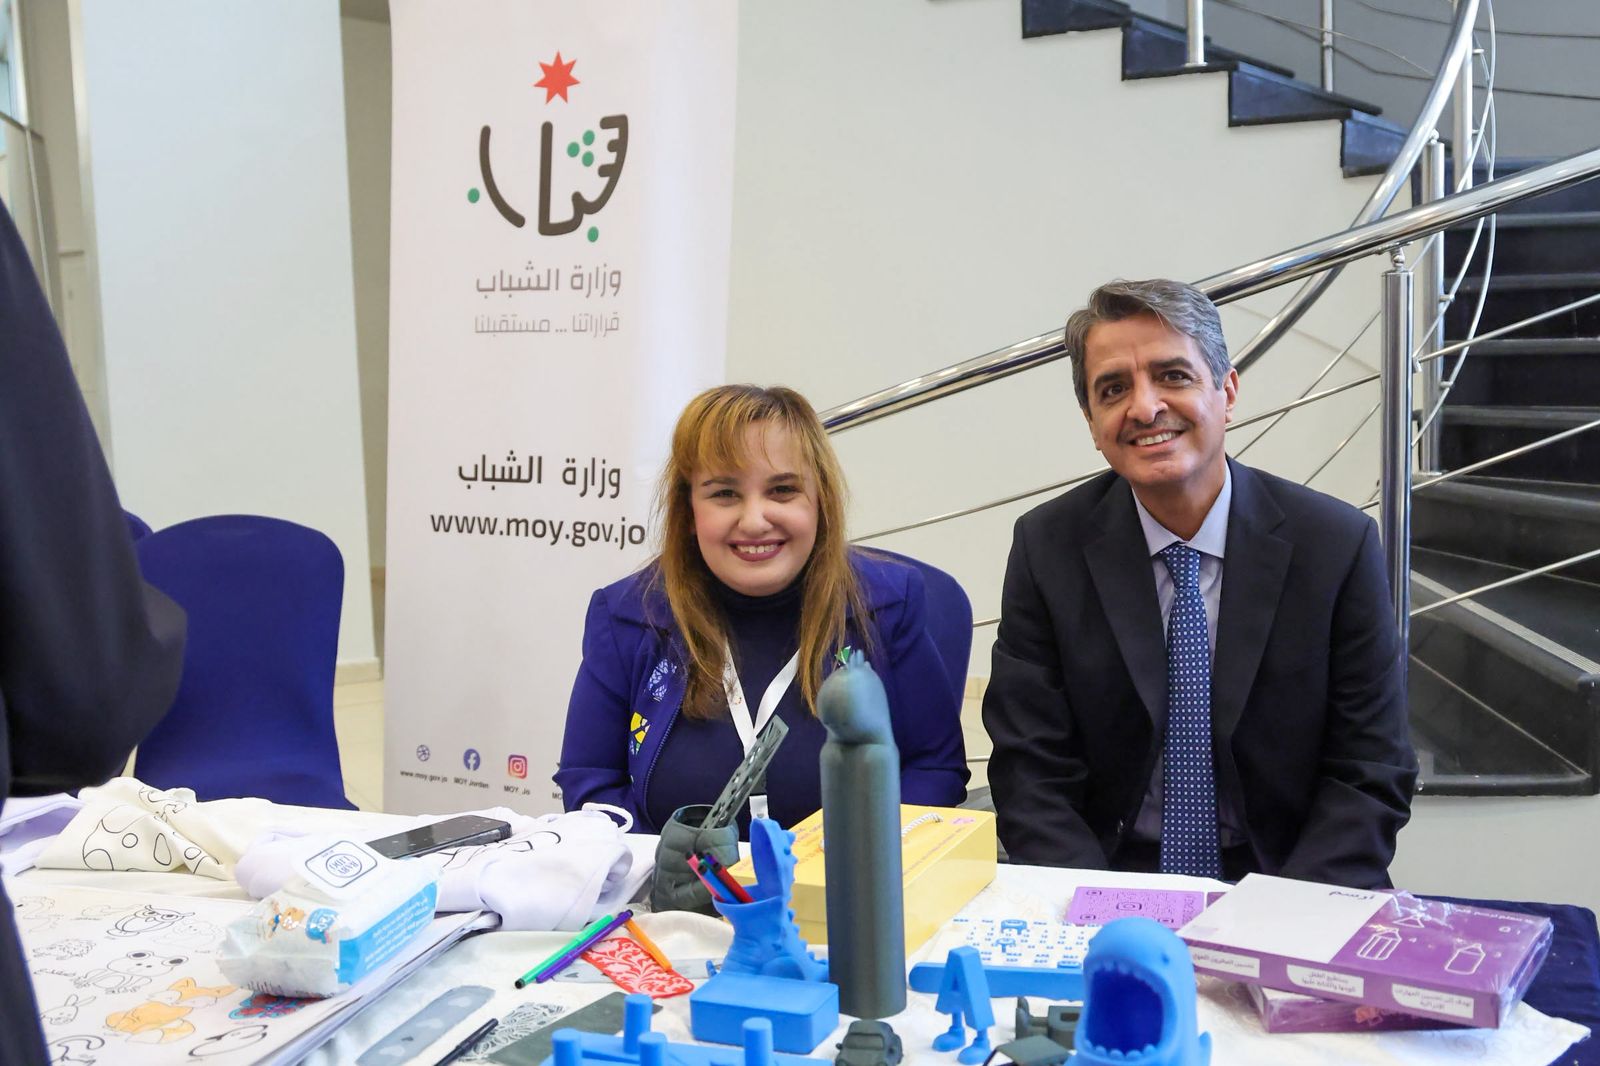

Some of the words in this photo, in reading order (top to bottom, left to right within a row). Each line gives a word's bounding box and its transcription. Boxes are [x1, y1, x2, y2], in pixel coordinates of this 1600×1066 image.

[475, 260, 560, 299] الشباب
[571, 263, 622, 298] وزارة
[458, 449, 542, 491] الشباب
[562, 457, 621, 499] وزارة
[430, 513, 646, 550] www.moy.gov.jo
